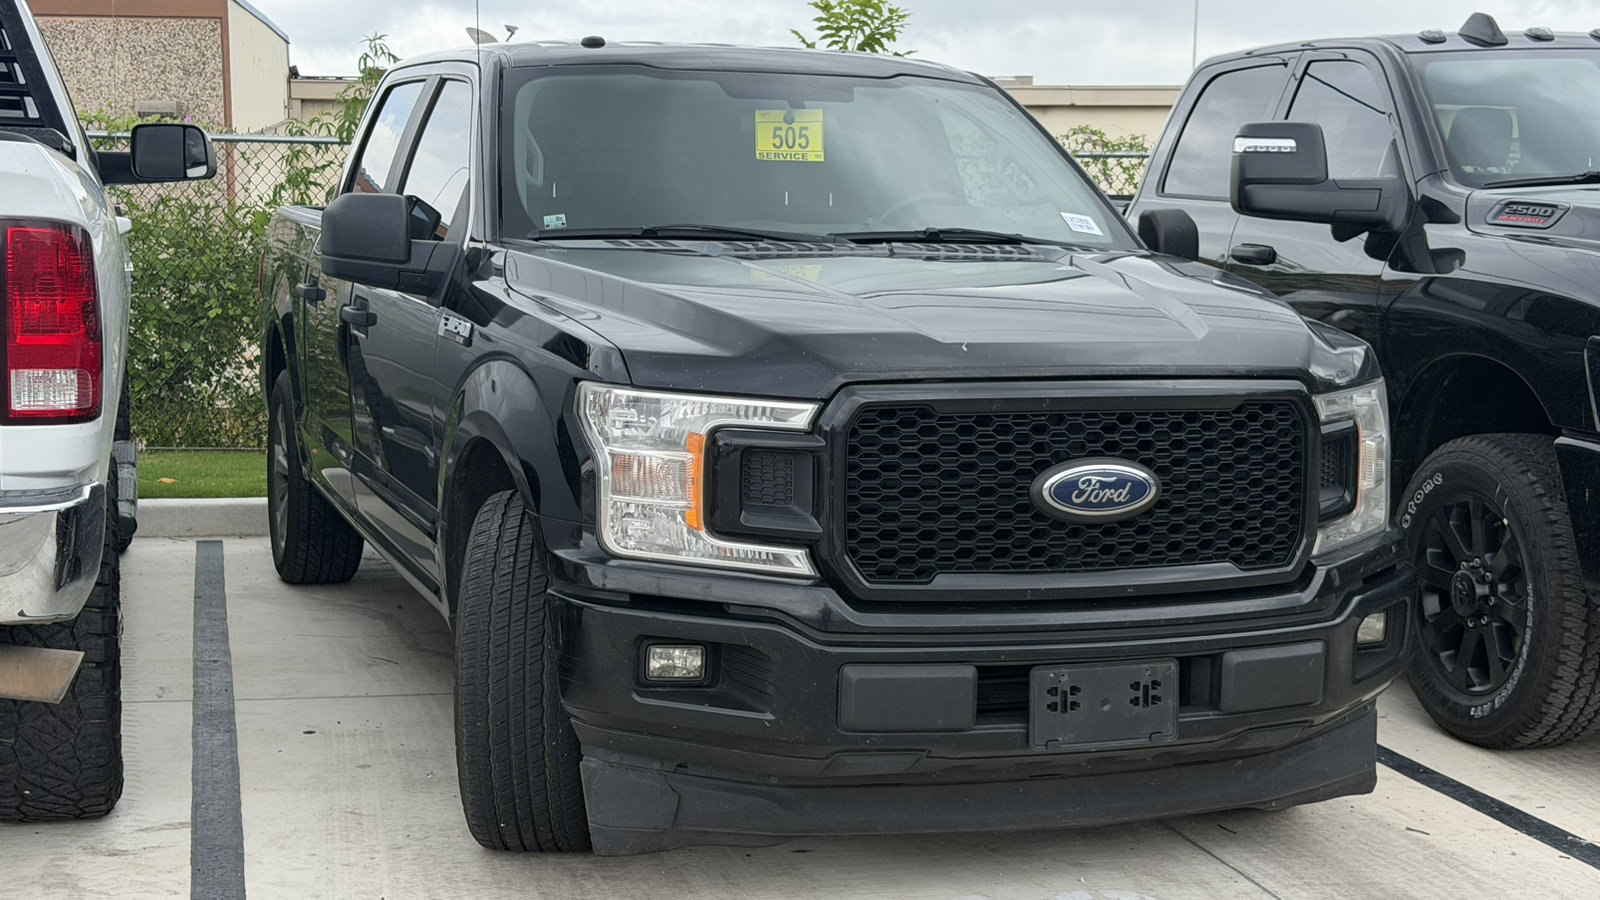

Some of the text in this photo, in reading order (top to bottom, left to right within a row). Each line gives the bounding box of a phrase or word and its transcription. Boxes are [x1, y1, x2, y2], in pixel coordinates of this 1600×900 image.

[772, 126, 809, 149] 505
[758, 152, 808, 160] SERVICE
[1504, 205, 1552, 215] 2500
[1072, 476, 1132, 503] Ford
